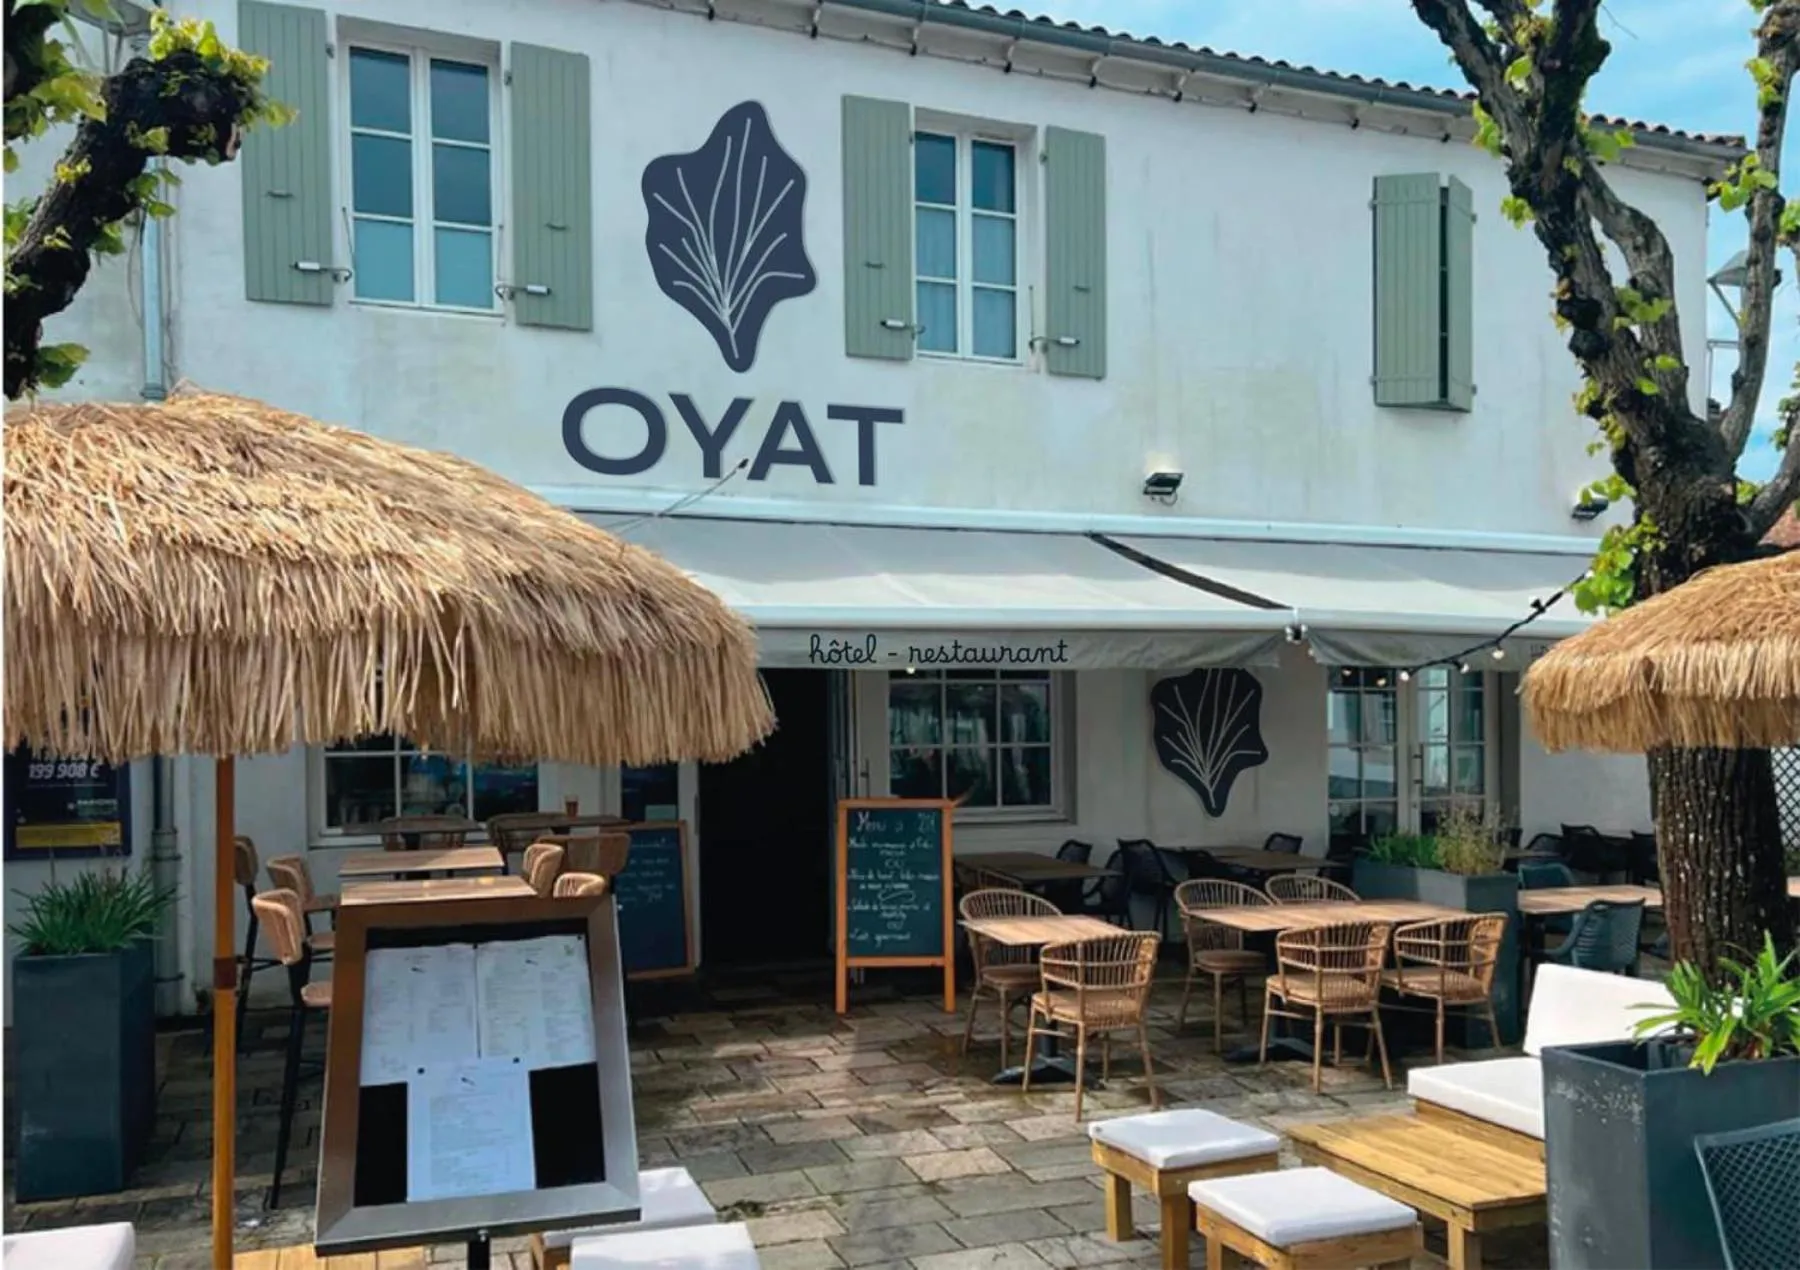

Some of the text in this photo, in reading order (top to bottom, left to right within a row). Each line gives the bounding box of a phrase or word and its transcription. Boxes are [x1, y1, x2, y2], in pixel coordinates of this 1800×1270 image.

[562, 387, 904, 486] OYAT
[808, 633, 877, 664] hôtel
[908, 638, 1069, 664] restaurant
